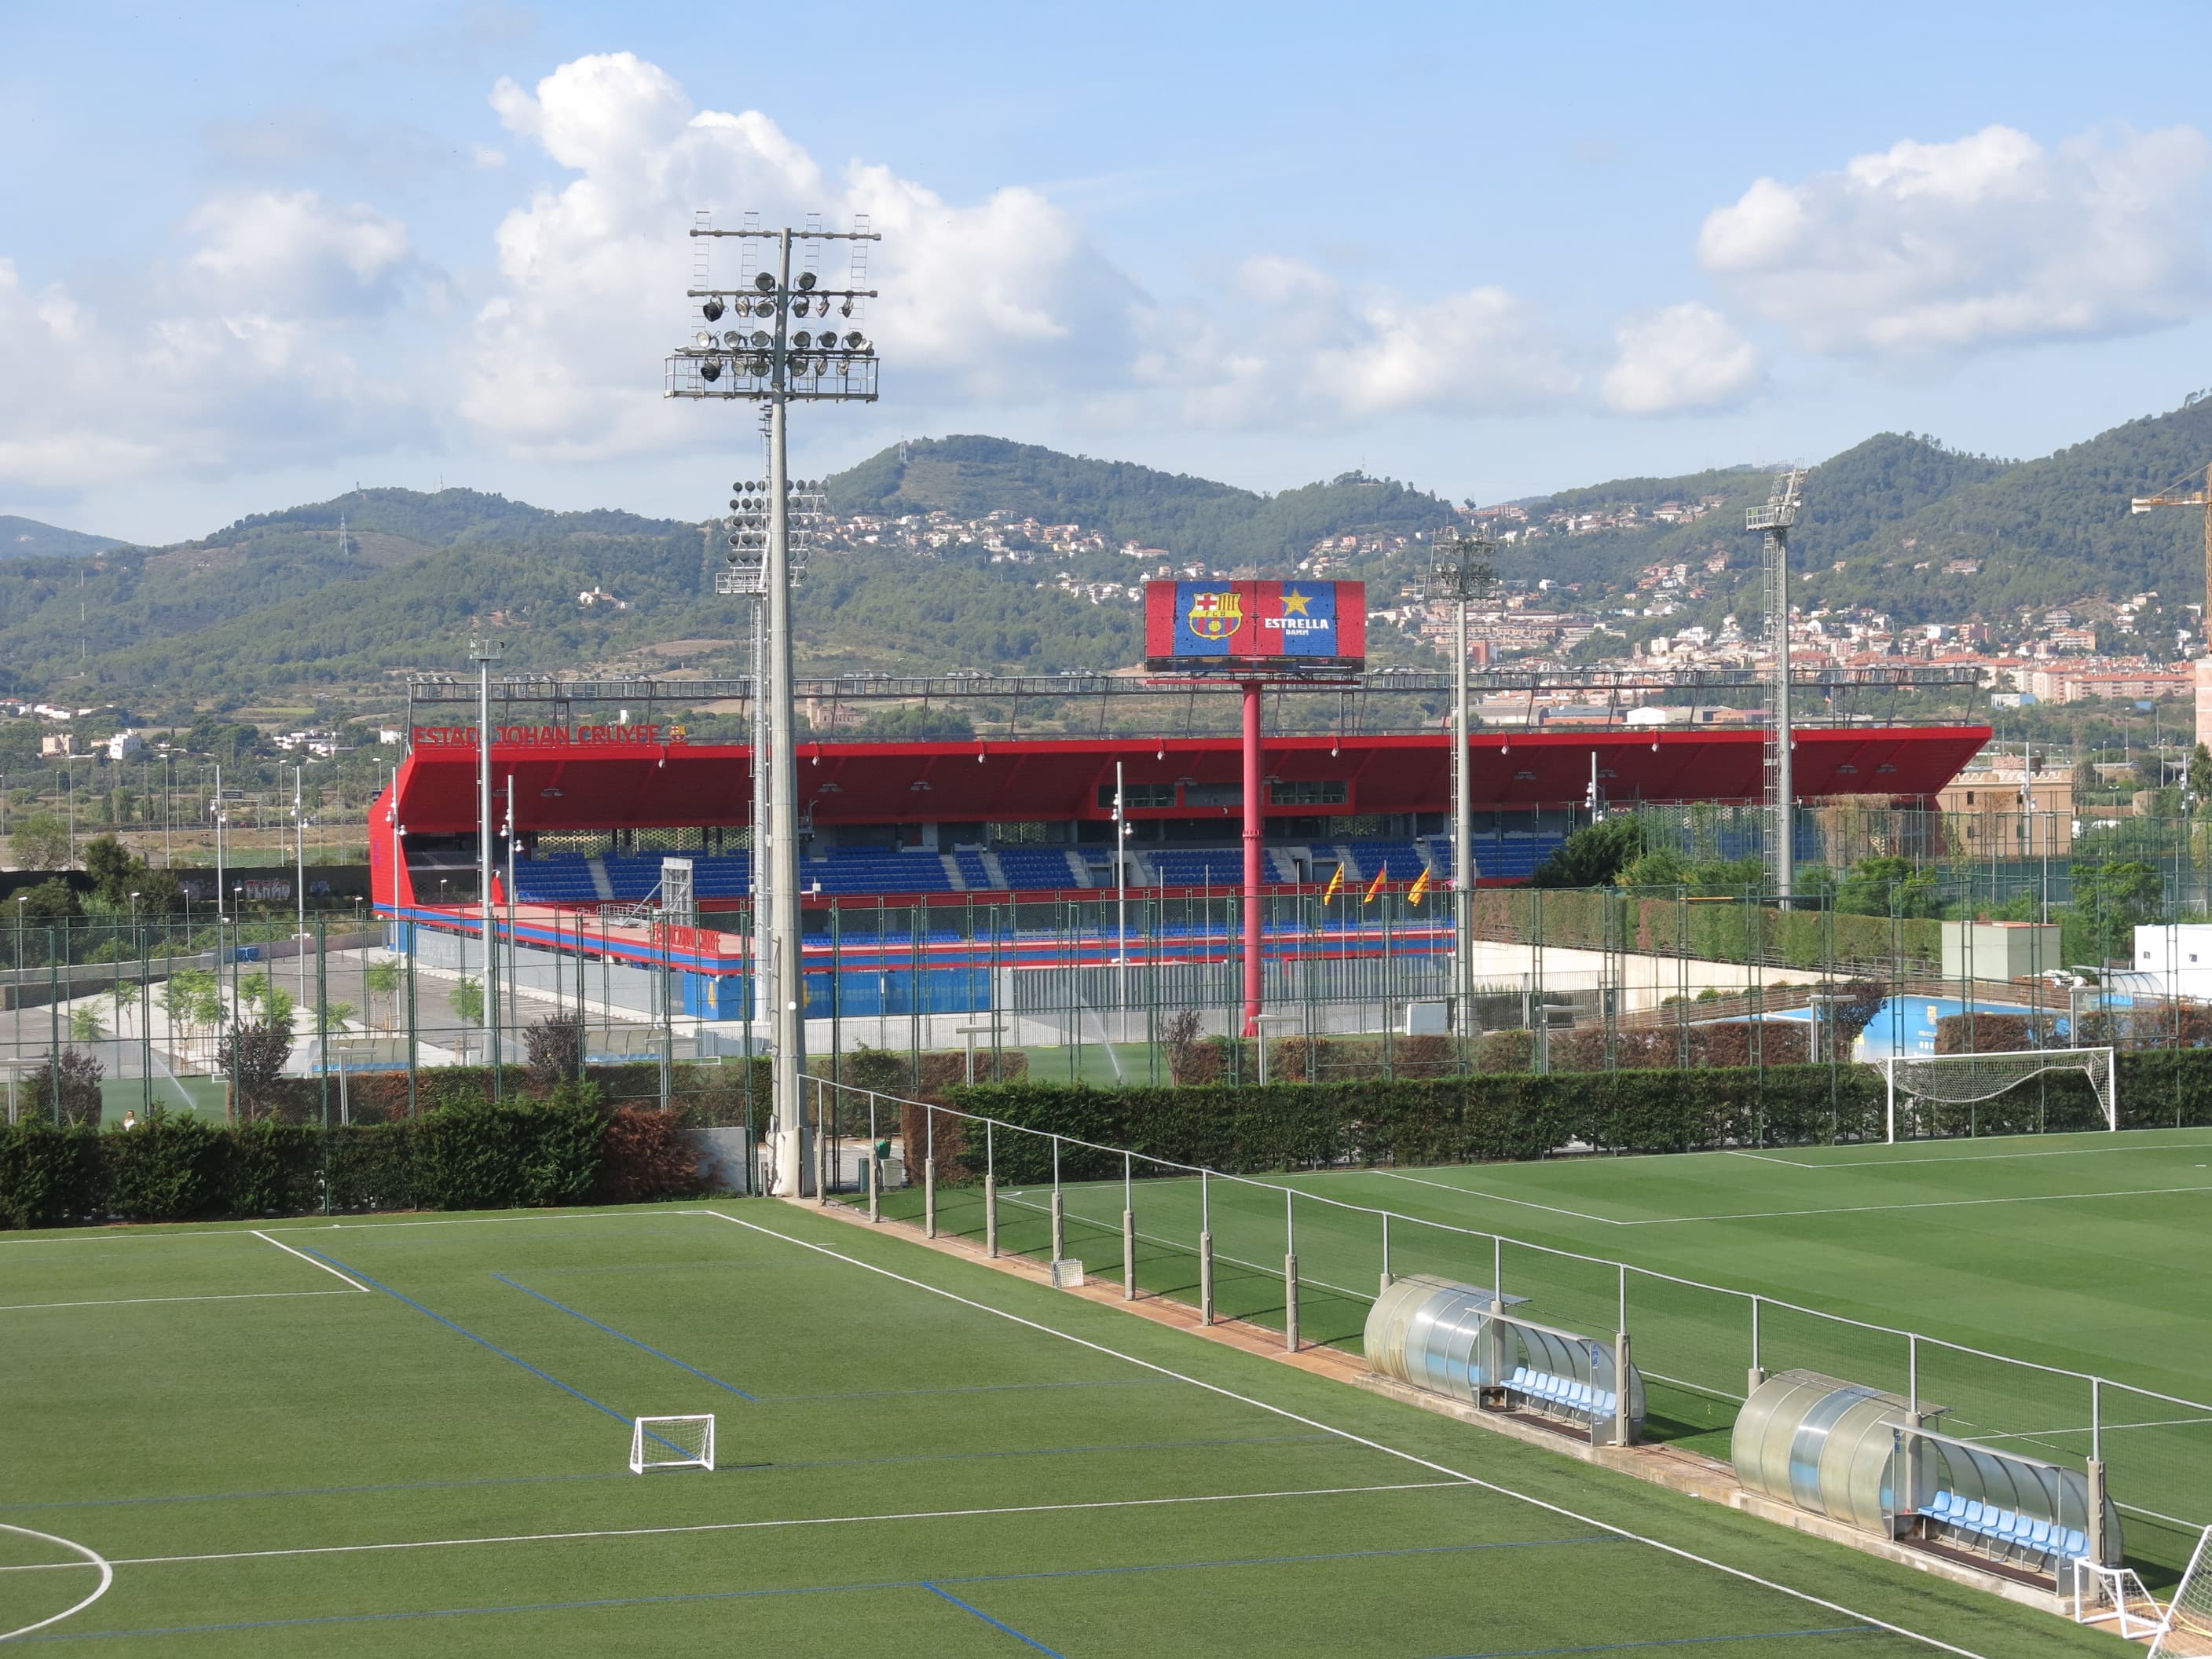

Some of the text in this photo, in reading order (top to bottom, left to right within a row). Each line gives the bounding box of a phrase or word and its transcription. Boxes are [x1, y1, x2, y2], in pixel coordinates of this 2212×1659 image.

[1264, 617, 1330, 629] ESTRELLA
[413, 724, 661, 745] ESTAD JOHAN CRUYFF
